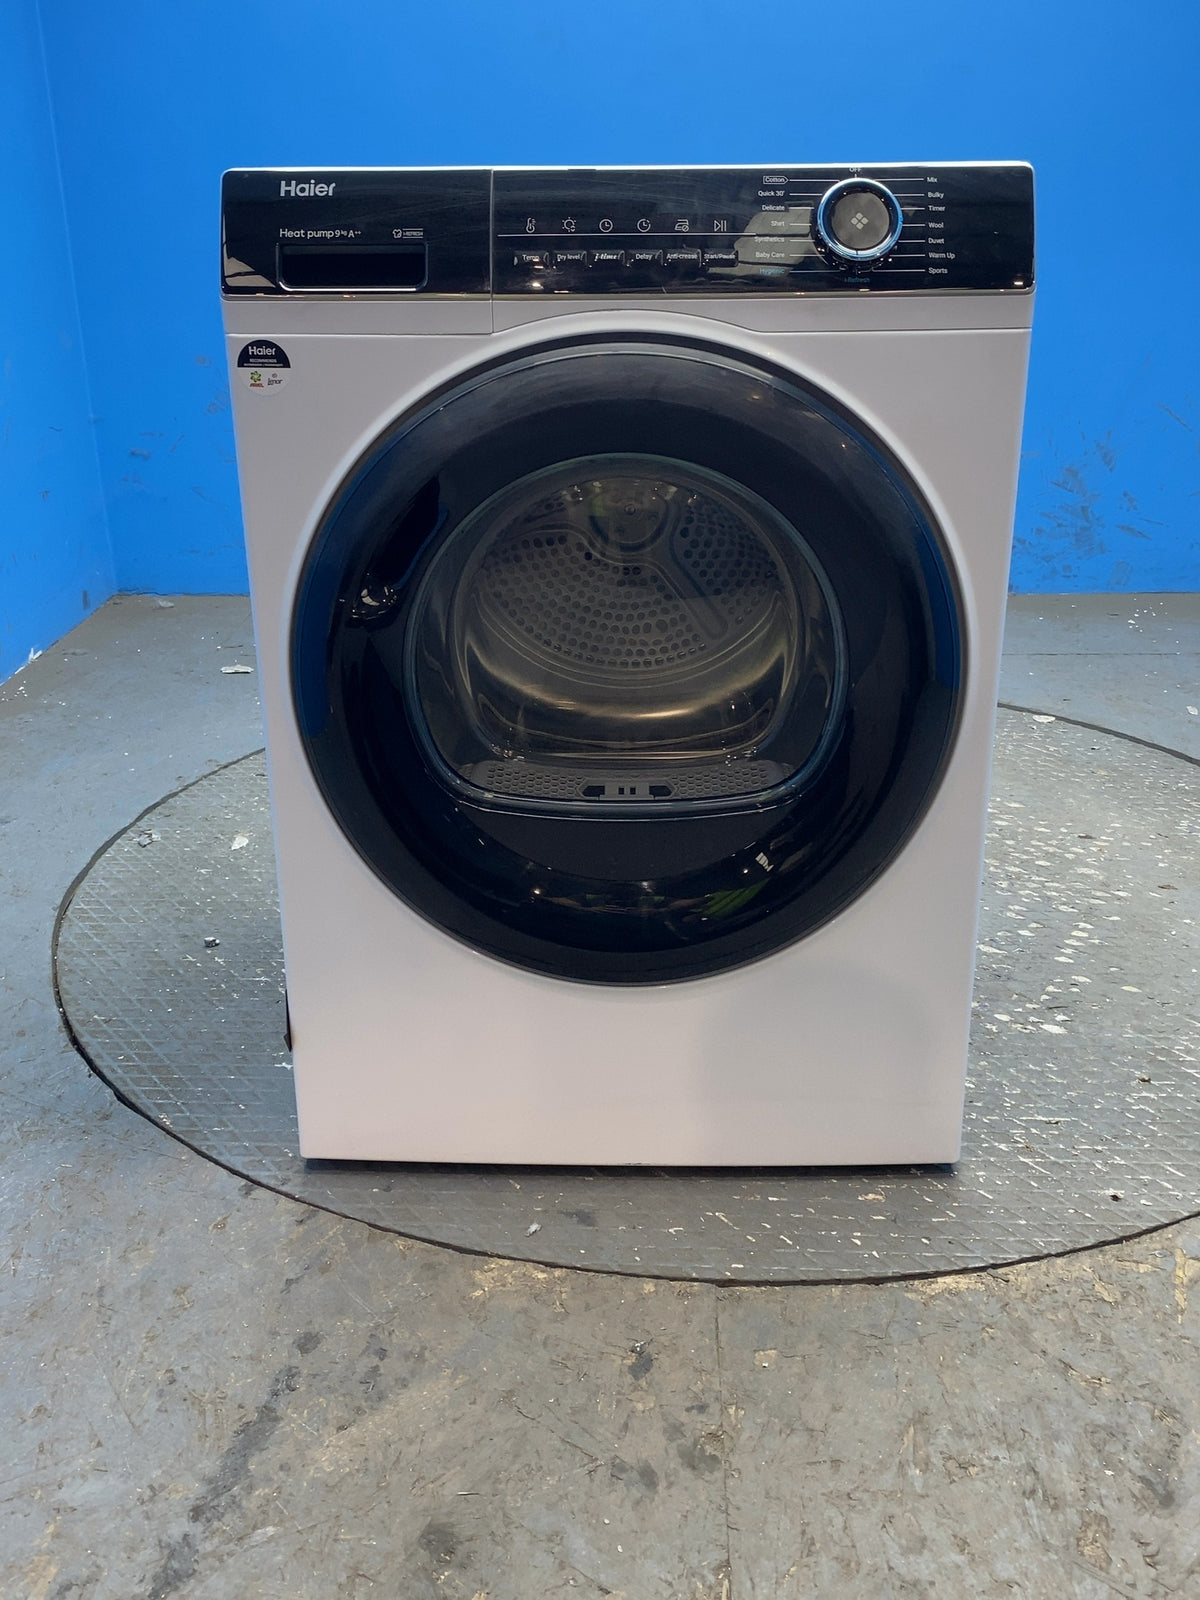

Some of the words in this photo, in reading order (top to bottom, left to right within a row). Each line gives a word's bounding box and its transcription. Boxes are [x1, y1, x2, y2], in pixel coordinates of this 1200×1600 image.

[279, 180, 336, 197] Haier
[927, 191, 944, 199] Bulky
[279, 228, 306, 238] Heat
[306, 229, 335, 240] pump
[557, 254, 567, 262] Dry
[635, 253, 653, 261] Delay
[755, 251, 771, 259] Baby
[946, 252, 956, 260] Up
[928, 267, 948, 275] Sports
[248, 346, 276, 356] Haier
